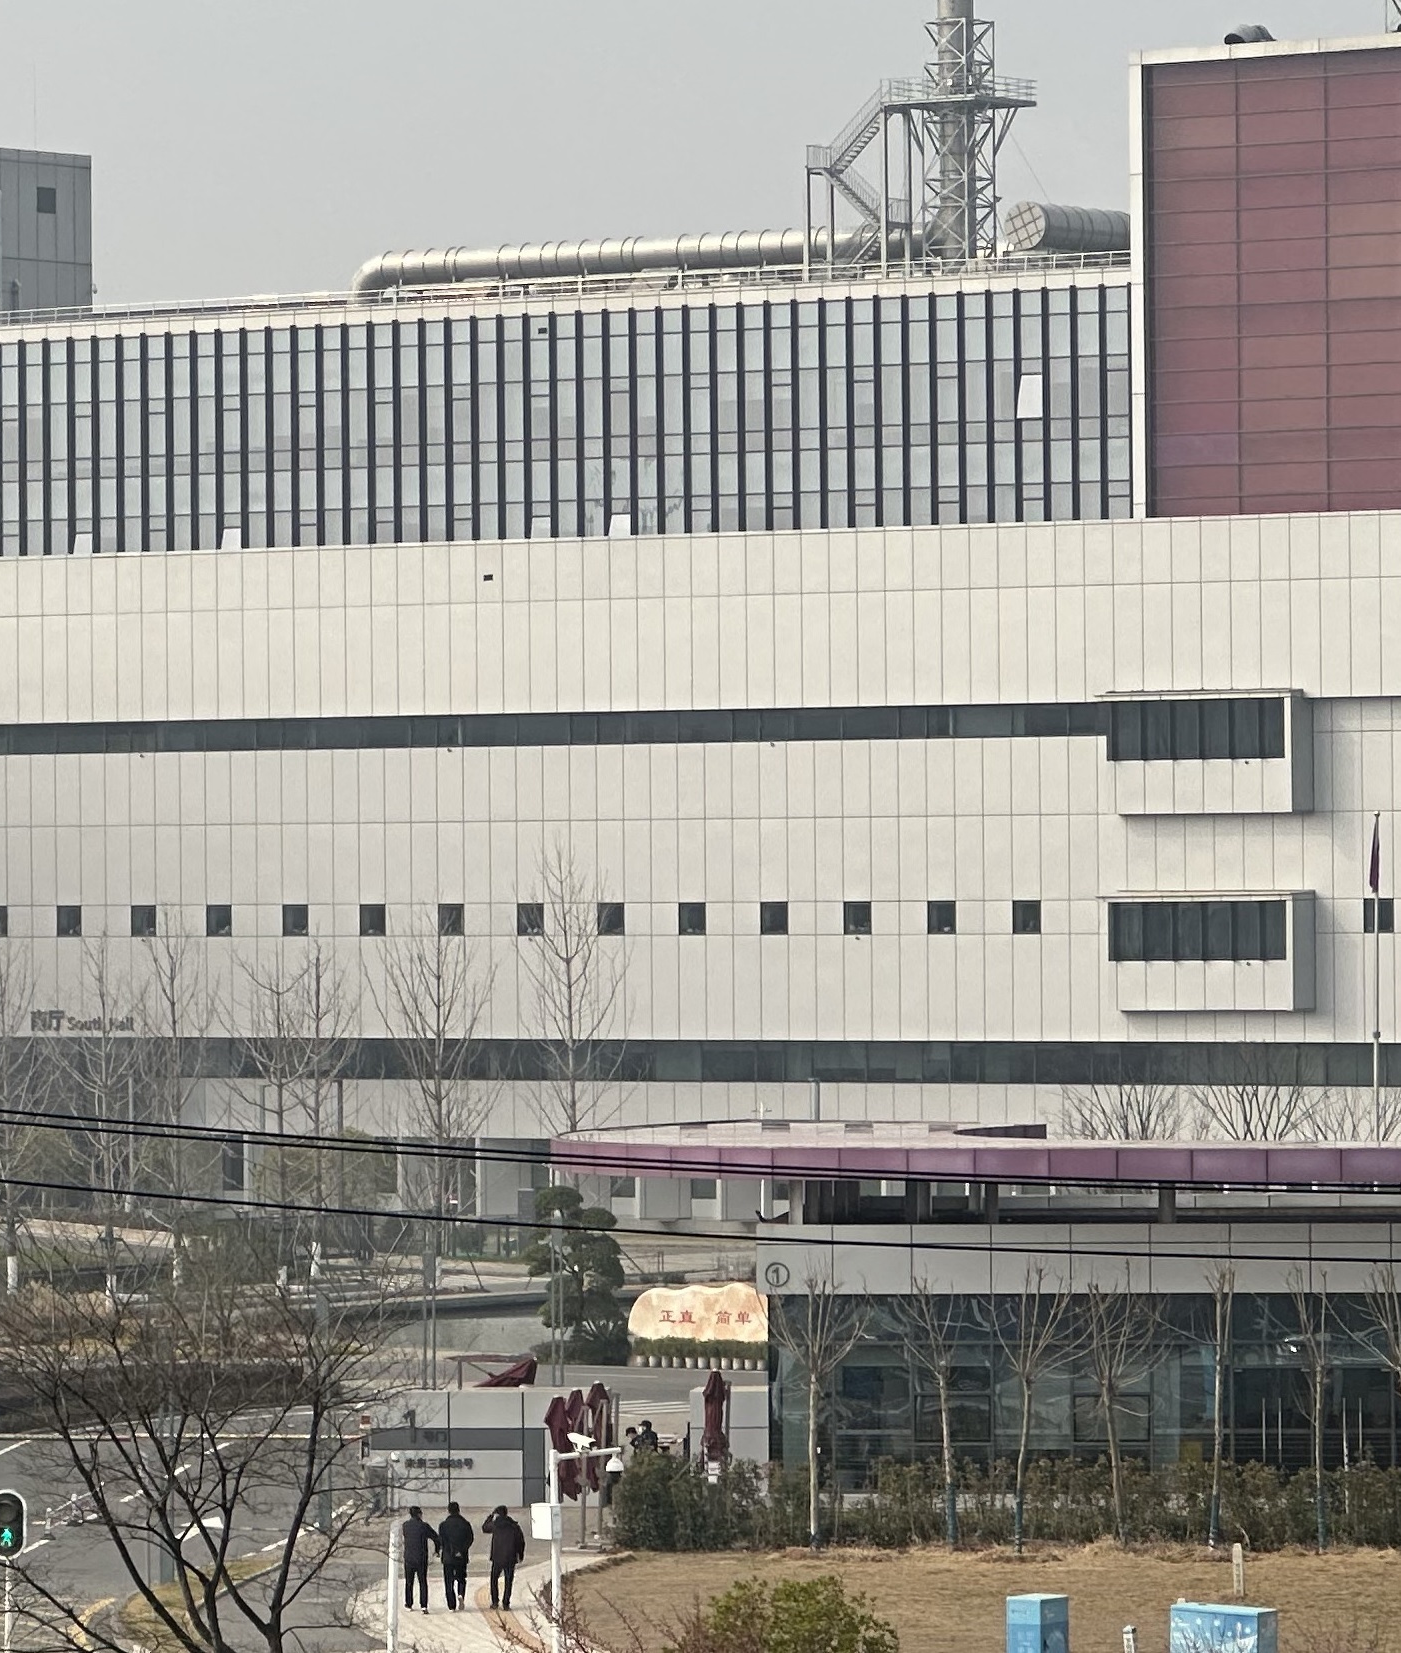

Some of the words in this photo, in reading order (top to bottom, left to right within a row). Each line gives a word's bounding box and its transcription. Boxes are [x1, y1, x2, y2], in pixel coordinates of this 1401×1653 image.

[67, 1016, 103, 1031] South
[659, 1310, 696, 1325] 正直
[715, 1310, 752, 1325] 简单
